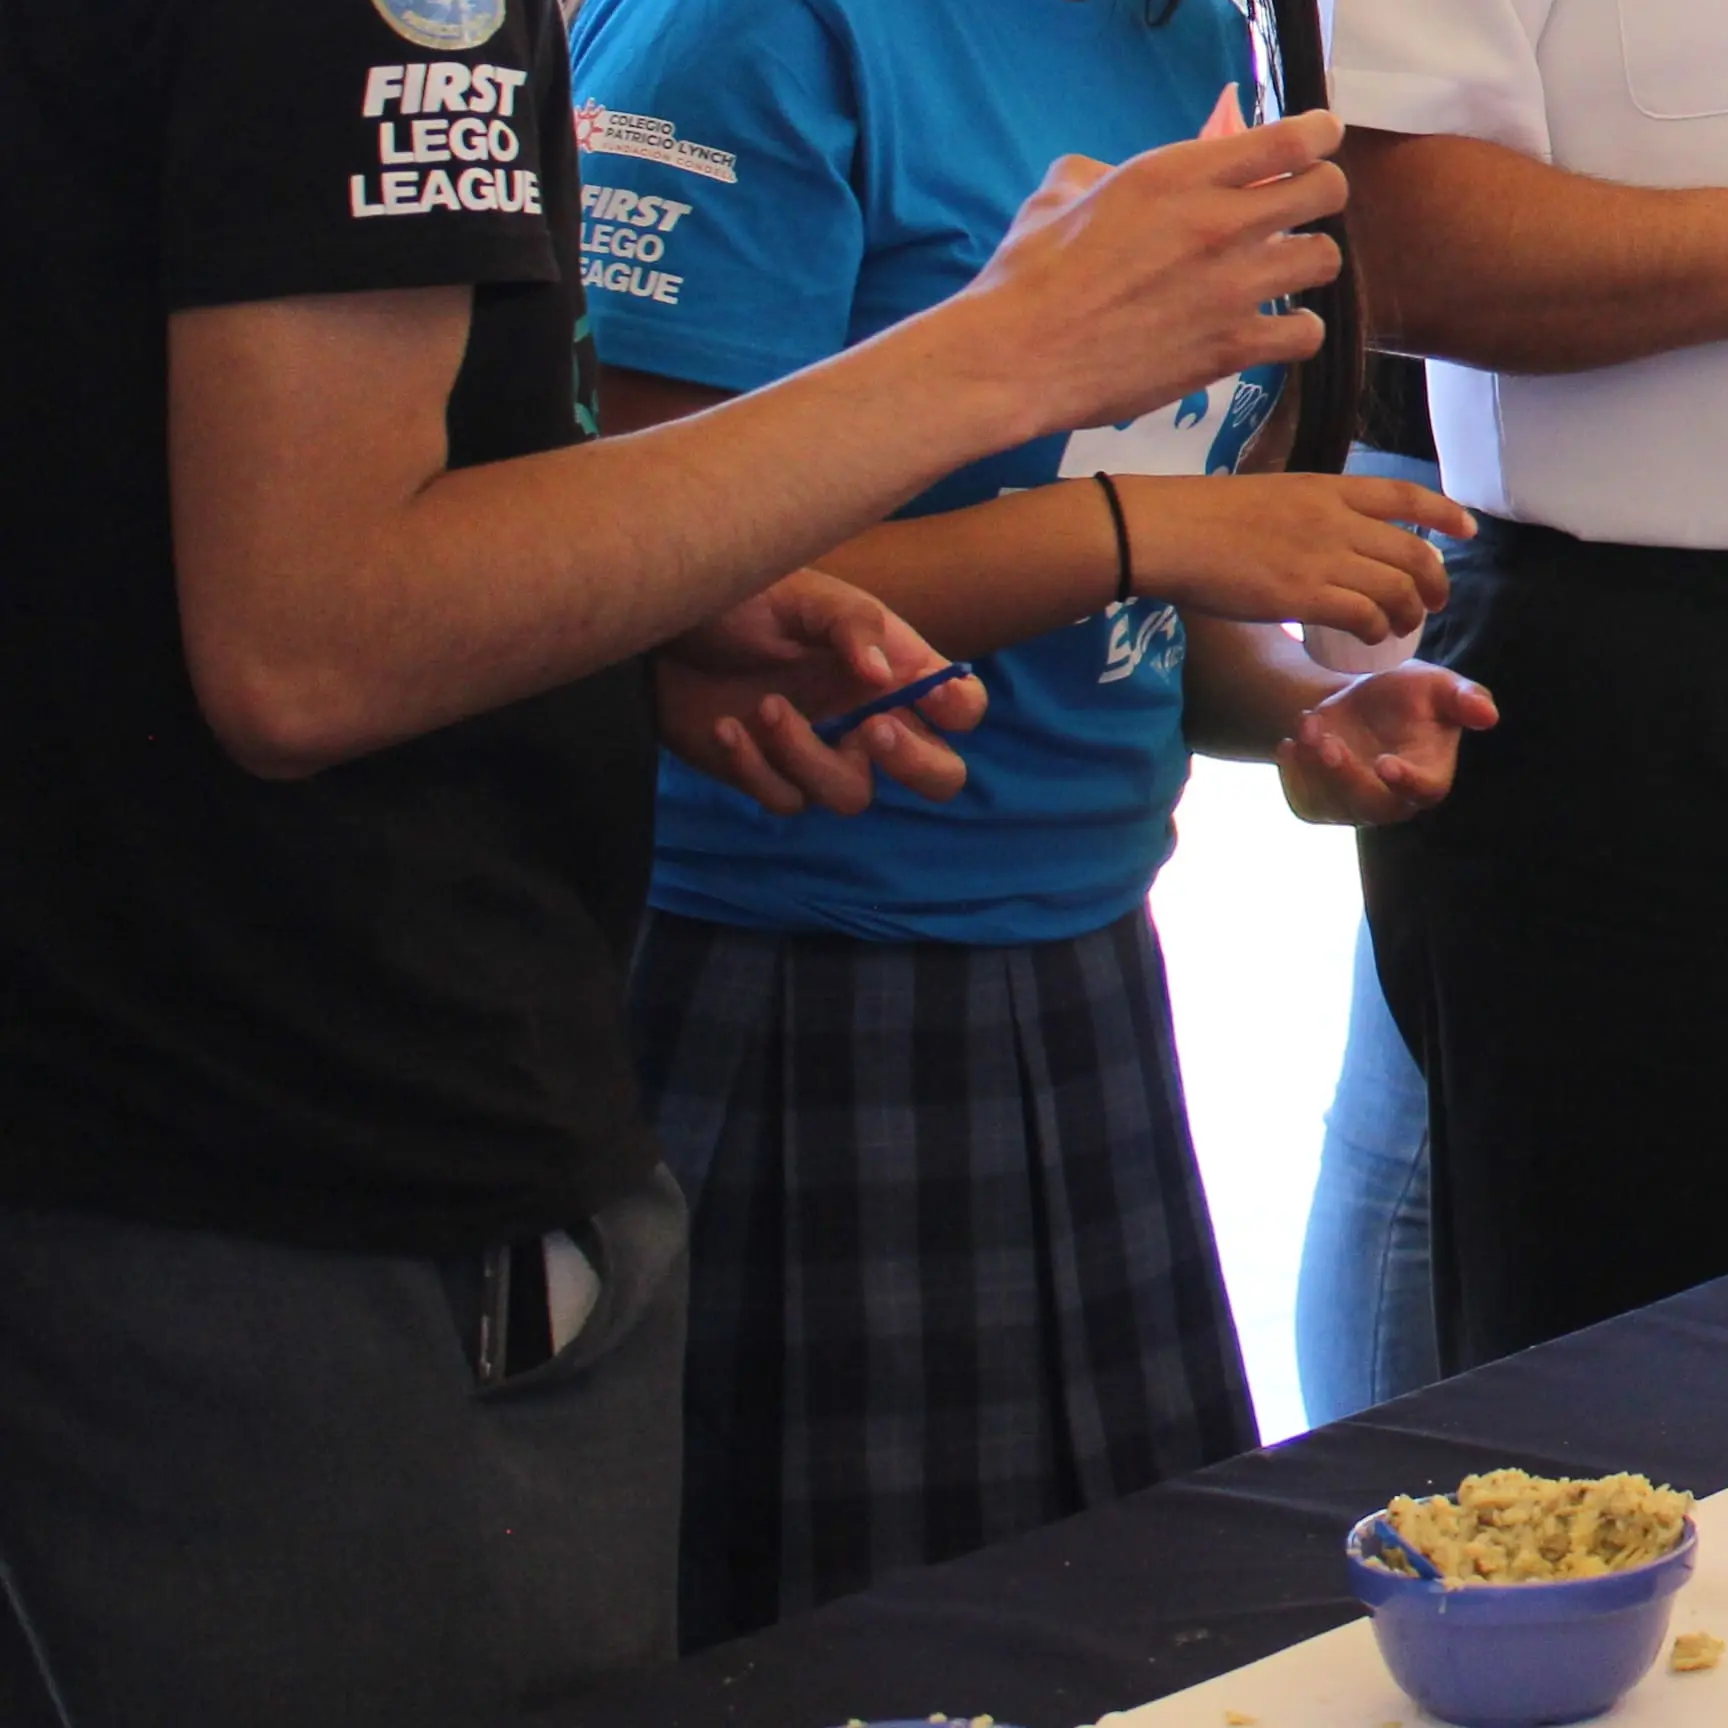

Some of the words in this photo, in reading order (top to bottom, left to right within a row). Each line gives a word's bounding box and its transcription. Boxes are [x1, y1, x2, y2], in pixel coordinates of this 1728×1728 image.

[362, 61, 527, 118] FIRST
[379, 117, 520, 165] LEGO
[605, 127, 675, 150] PATRICIO
[678, 142, 734, 167] LYNCH
[608, 113, 673, 135] COLEGIO
[350, 166, 543, 218] LEAGUE
[580, 183, 693, 232] FIRST
[579, 222, 665, 263] LEGO
[578, 256, 684, 305] EAGUE
